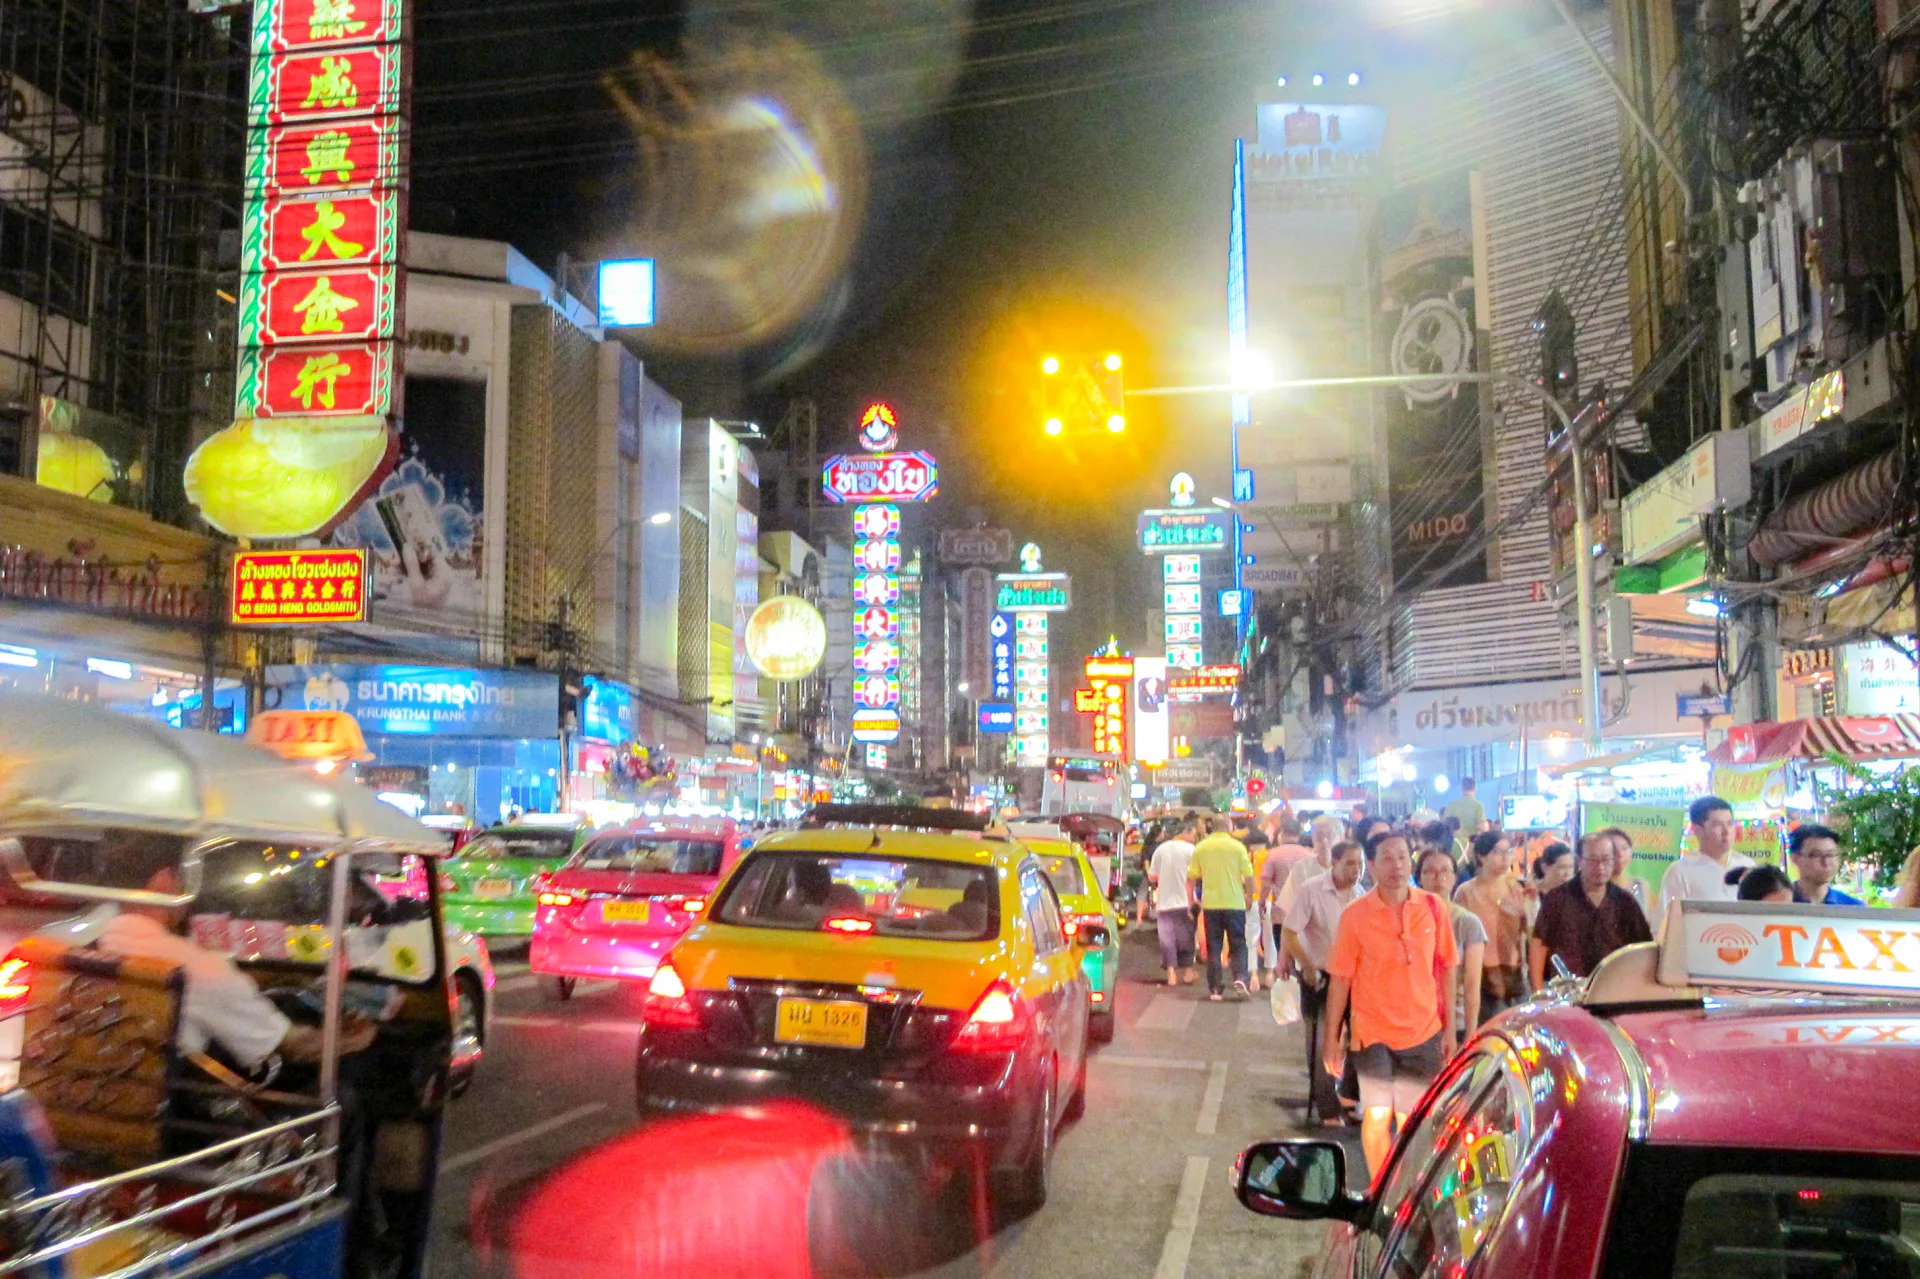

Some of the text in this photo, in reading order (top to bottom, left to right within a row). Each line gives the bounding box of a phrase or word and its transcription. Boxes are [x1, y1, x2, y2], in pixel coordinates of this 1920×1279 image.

[1408, 513, 1466, 541] MIDO
[357, 707, 431, 722] KRUNGTHAI
[433, 709, 467, 722] BANK
[262, 716, 338, 743] TAXI
[1631, 851, 1676, 862] moothie
